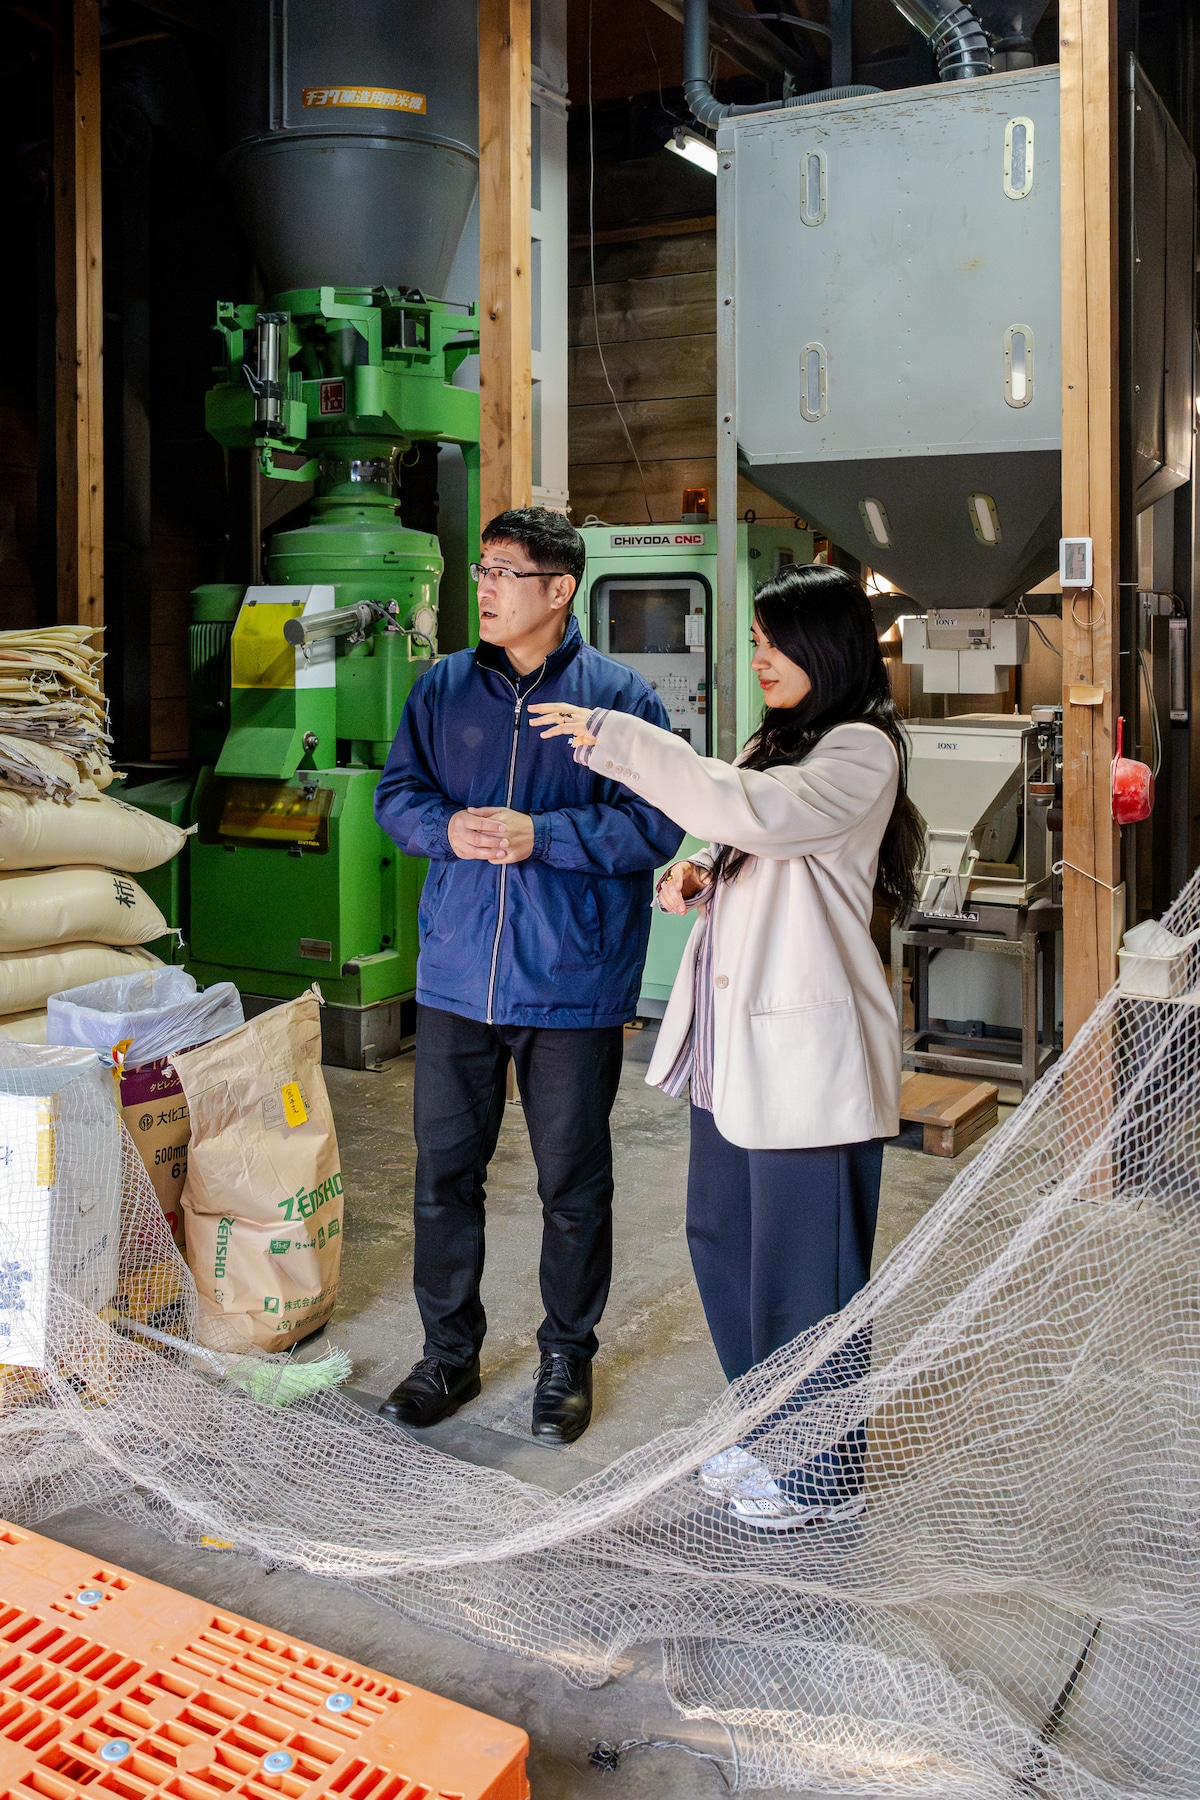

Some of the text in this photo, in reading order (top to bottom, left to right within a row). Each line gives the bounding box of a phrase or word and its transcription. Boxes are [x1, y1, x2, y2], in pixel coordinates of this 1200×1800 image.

[614, 535, 702, 545] CHIYODA CNC
[157, 1106, 189, 1126] 大化工
